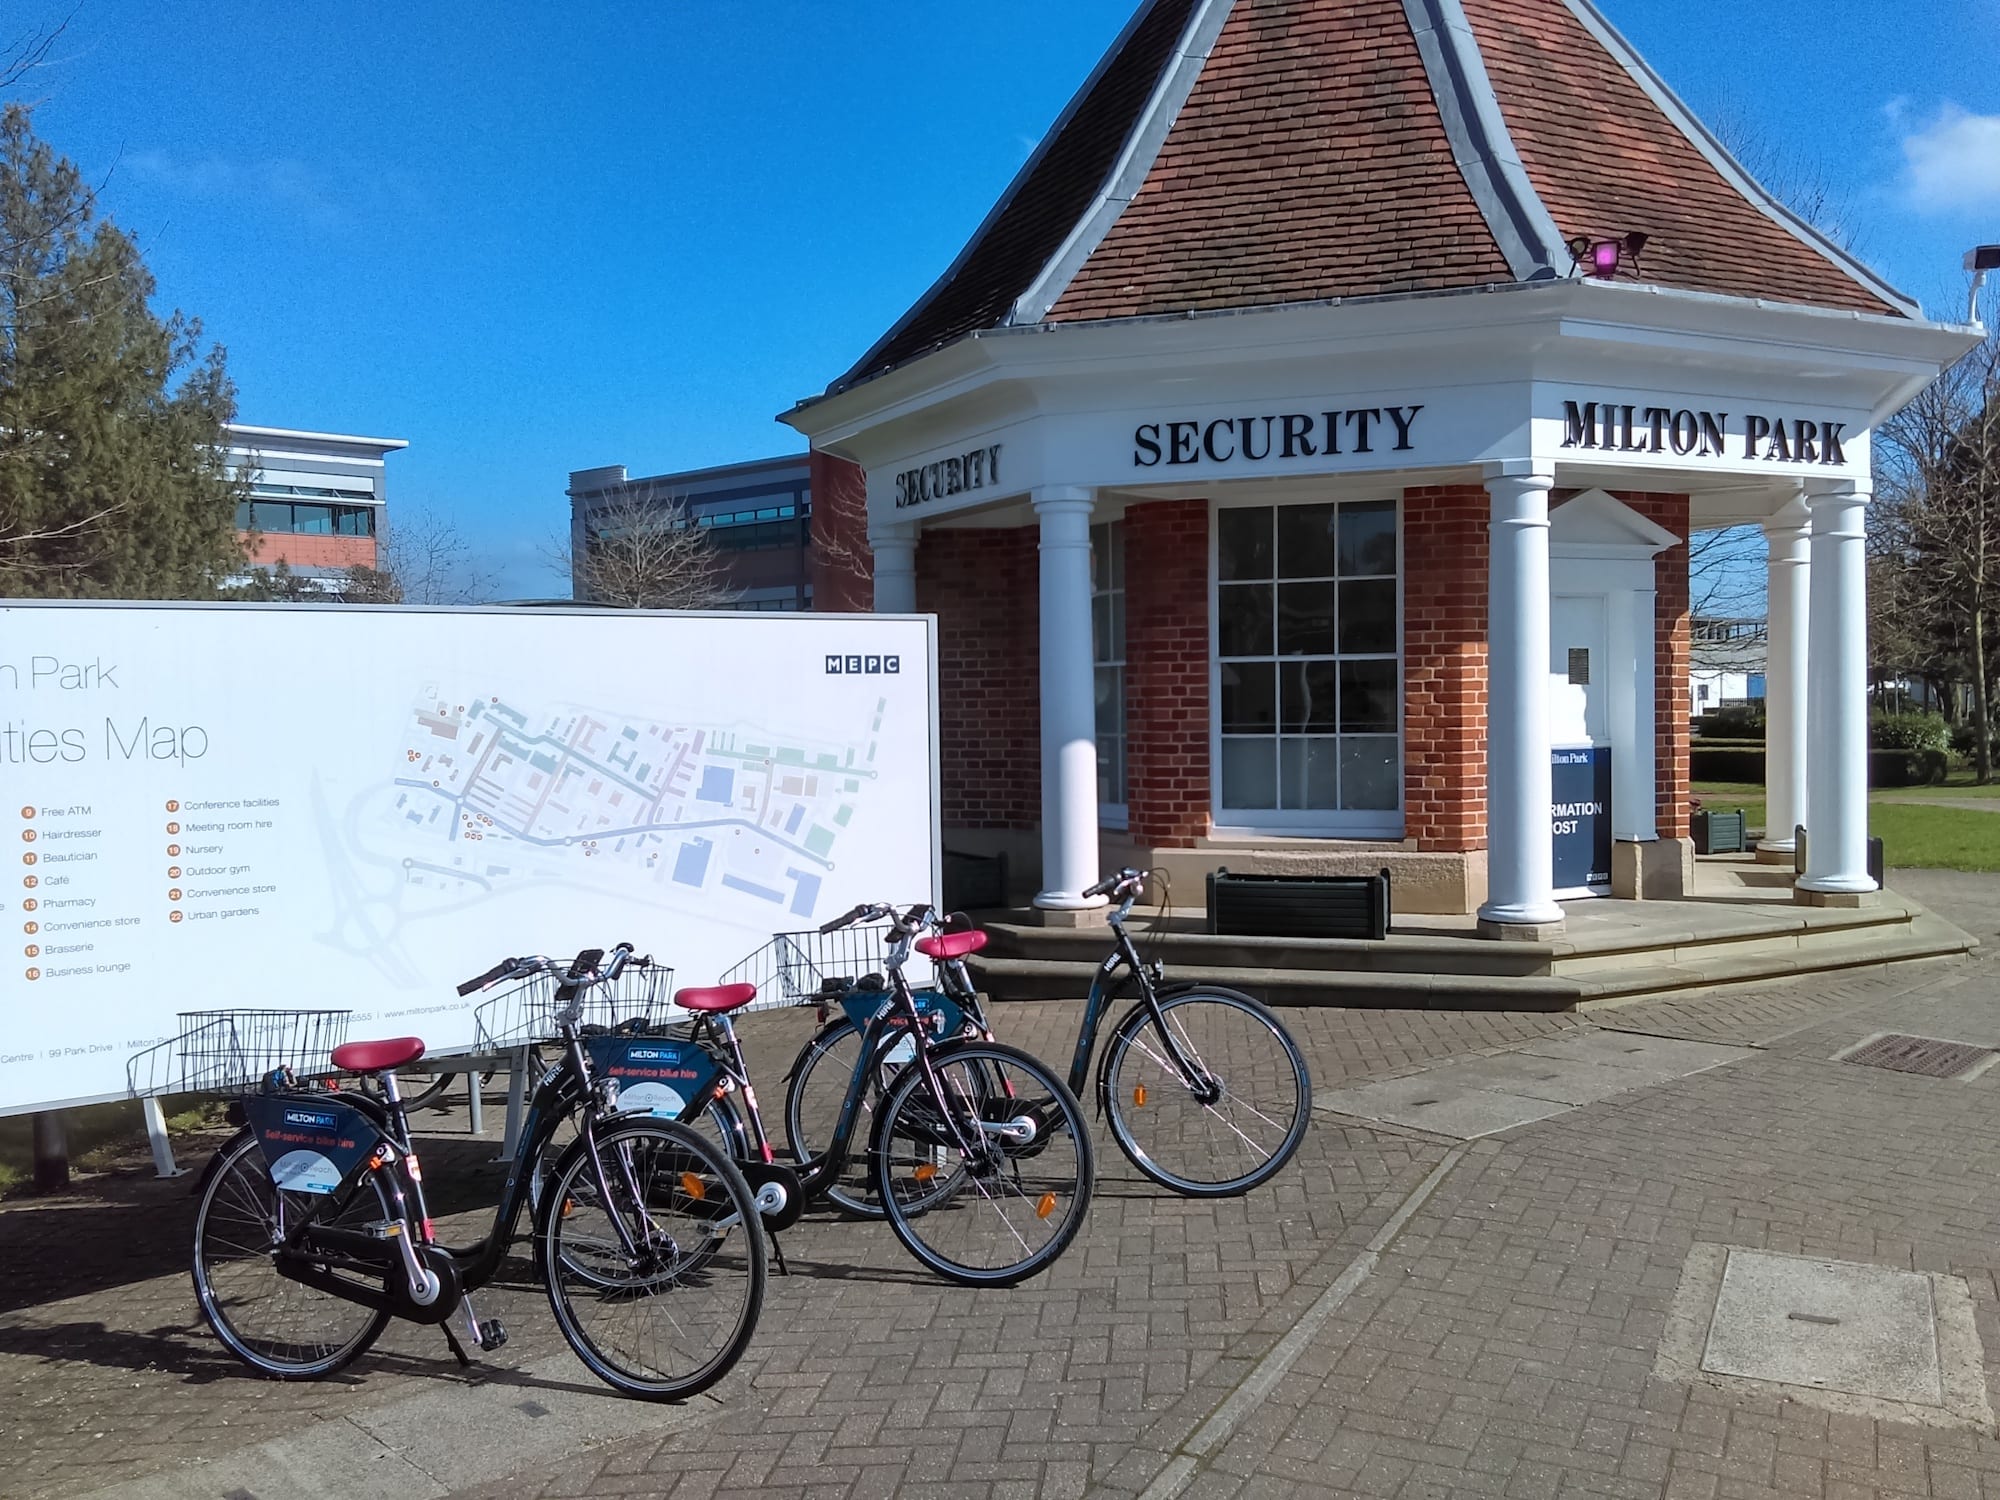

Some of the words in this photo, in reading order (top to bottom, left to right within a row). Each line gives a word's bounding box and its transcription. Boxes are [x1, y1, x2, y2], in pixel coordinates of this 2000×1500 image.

[1134, 405, 1425, 467] SECURITY
[1560, 400, 1728, 458] MILTON
[1742, 415, 1848, 466] PARK
[895, 444, 1002, 509] SECURITY
[826, 656, 900, 673] MEPC
[32, 656, 119, 690] Park
[106, 716, 208, 768] Map
[1569, 753, 1588, 764] Park
[184, 801, 240, 810] Conference
[243, 798, 280, 808] facilities
[42, 808, 64, 817] Free
[67, 806, 91, 816] ATM
[185, 823, 224, 832] Meeting
[227, 822, 252, 830] room
[255, 820, 272, 828] hire
[42, 829, 101, 840] Hairdresser
[185, 845, 223, 854] Nursery
[43, 852, 98, 863] Beautician
[186, 866, 226, 876] Outdoor
[229, 865, 250, 875] gym
[187, 887, 249, 898] Convenience
[252, 884, 276, 894] store
[43, 897, 96, 908] Pharmacy
[188, 910, 218, 920] Urban
[220, 907, 259, 919] gardens
[44, 919, 112, 932] Convenience
[114, 916, 141, 926] store
[45, 943, 94, 955] Brasserie
[46, 966, 93, 977] Business
[96, 962, 131, 973] lounge
[876, 1000, 896, 1020] HIRE
[1, 1053, 34, 1064] Centre
[48, 1049, 62, 1058] 99
[64, 1046, 87, 1056] Park
[89, 1043, 113, 1053] Drive
[127, 1037, 155, 1049] Milton
[384, 1002, 470, 1018] www.miltonpark.co.uk
[630, 1050, 658, 1059] MILTON
[543, 1064, 565, 1087] HIRE
[659, 1067, 679, 1078] bike
[680, 1069, 698, 1079] hire
[287, 1112, 316, 1123] MILTON
[316, 1117, 334, 1126] PARK
